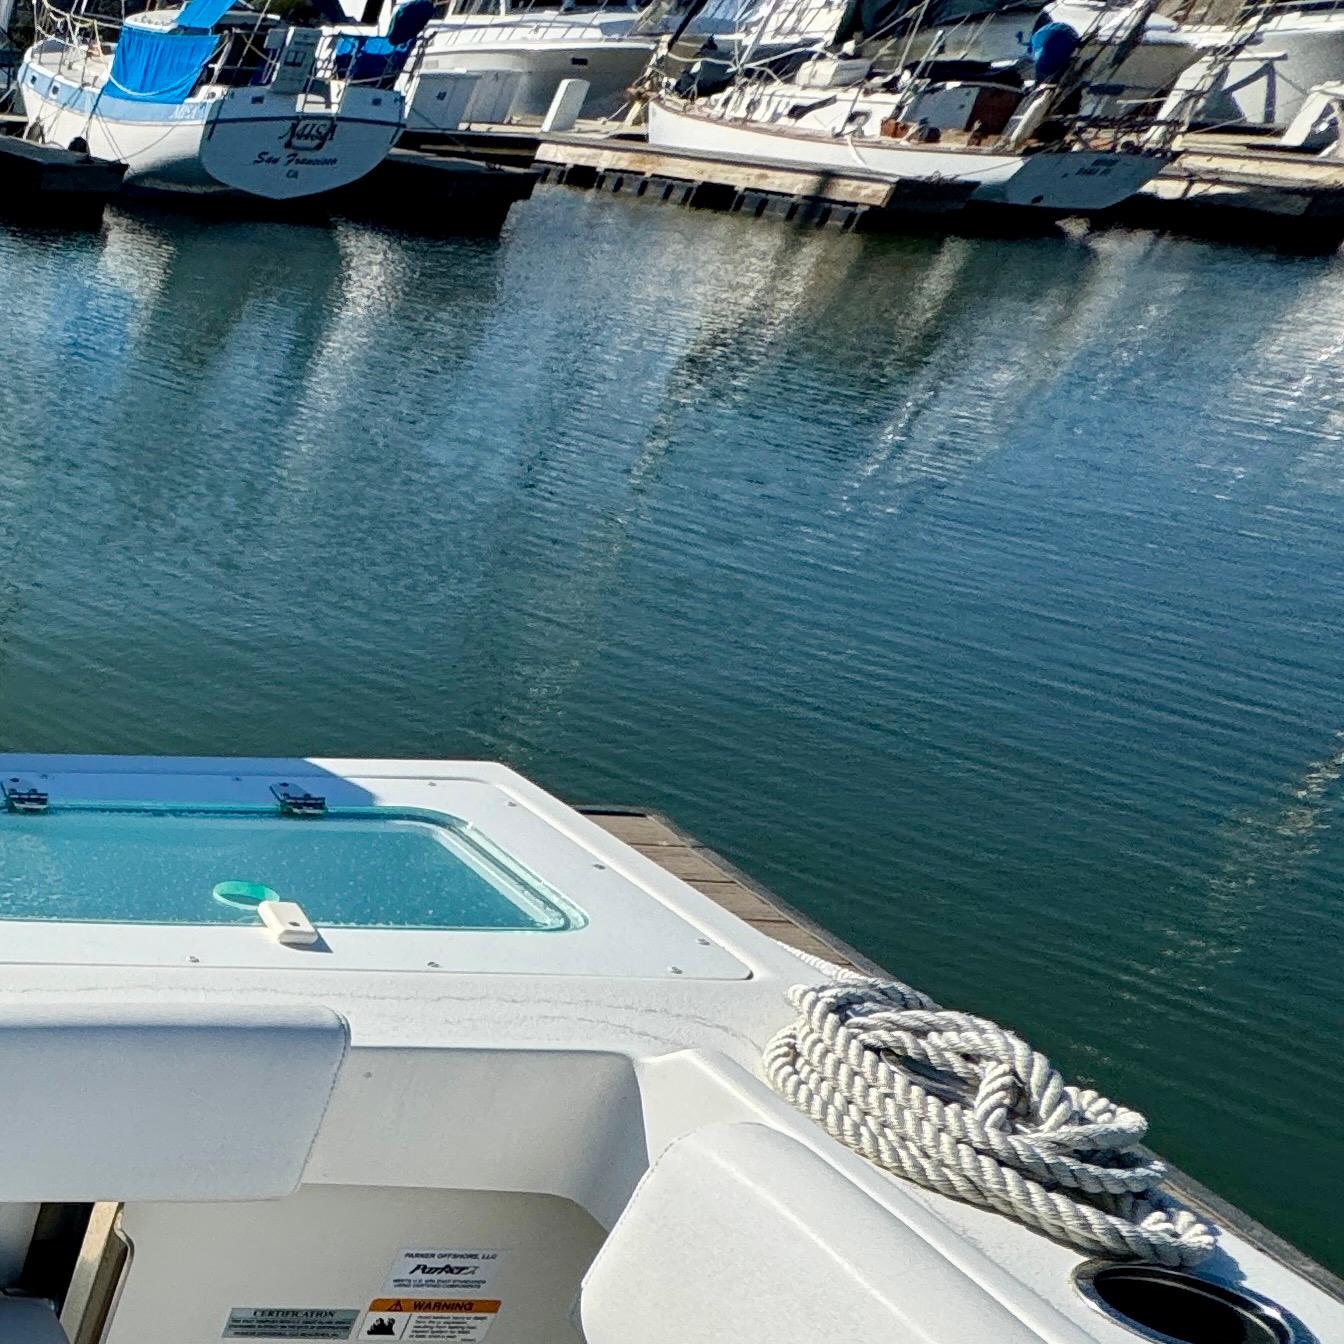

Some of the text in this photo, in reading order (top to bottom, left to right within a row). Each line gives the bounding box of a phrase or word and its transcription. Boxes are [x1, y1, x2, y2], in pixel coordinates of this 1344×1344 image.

[253, 151, 281, 165] San
[413, 1301, 474, 1311] WARNING
[253, 1309, 336, 1318] CERTIFICATION
